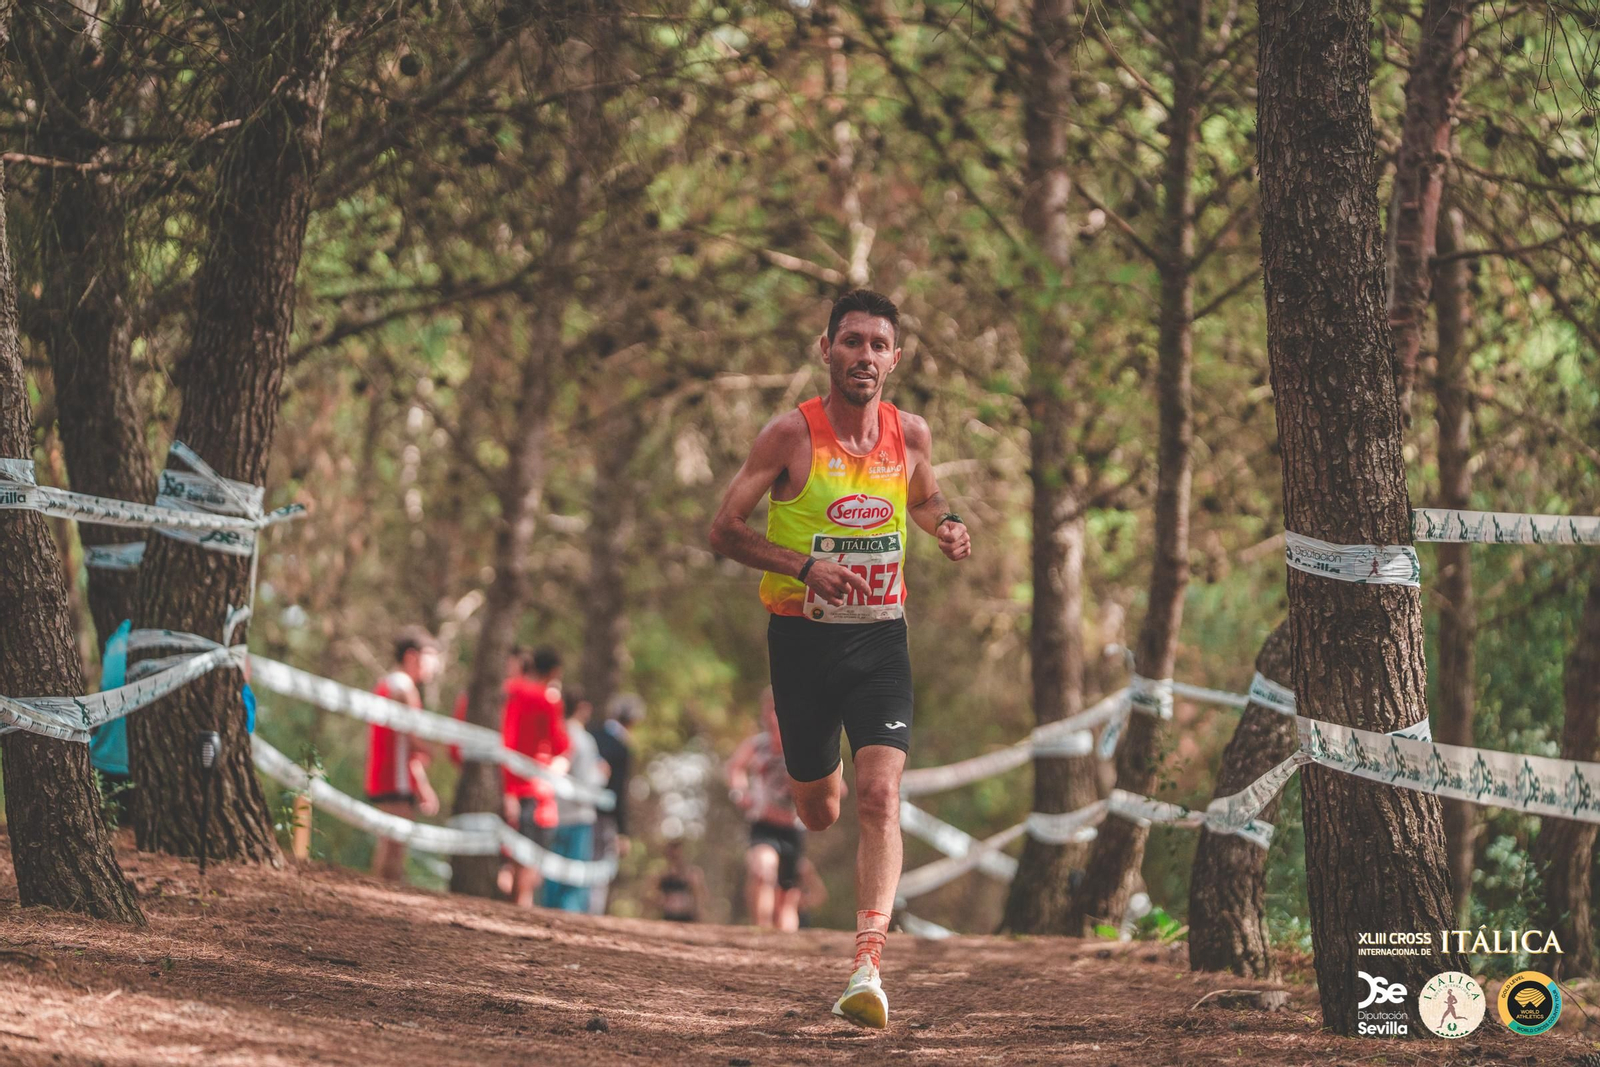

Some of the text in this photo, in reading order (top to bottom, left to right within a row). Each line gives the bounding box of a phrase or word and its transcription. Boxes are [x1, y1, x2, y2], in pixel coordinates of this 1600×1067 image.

[834, 504, 889, 519] Serrano
[841, 538, 884, 551] ITÁLICA
[807, 553, 899, 606] REZ
